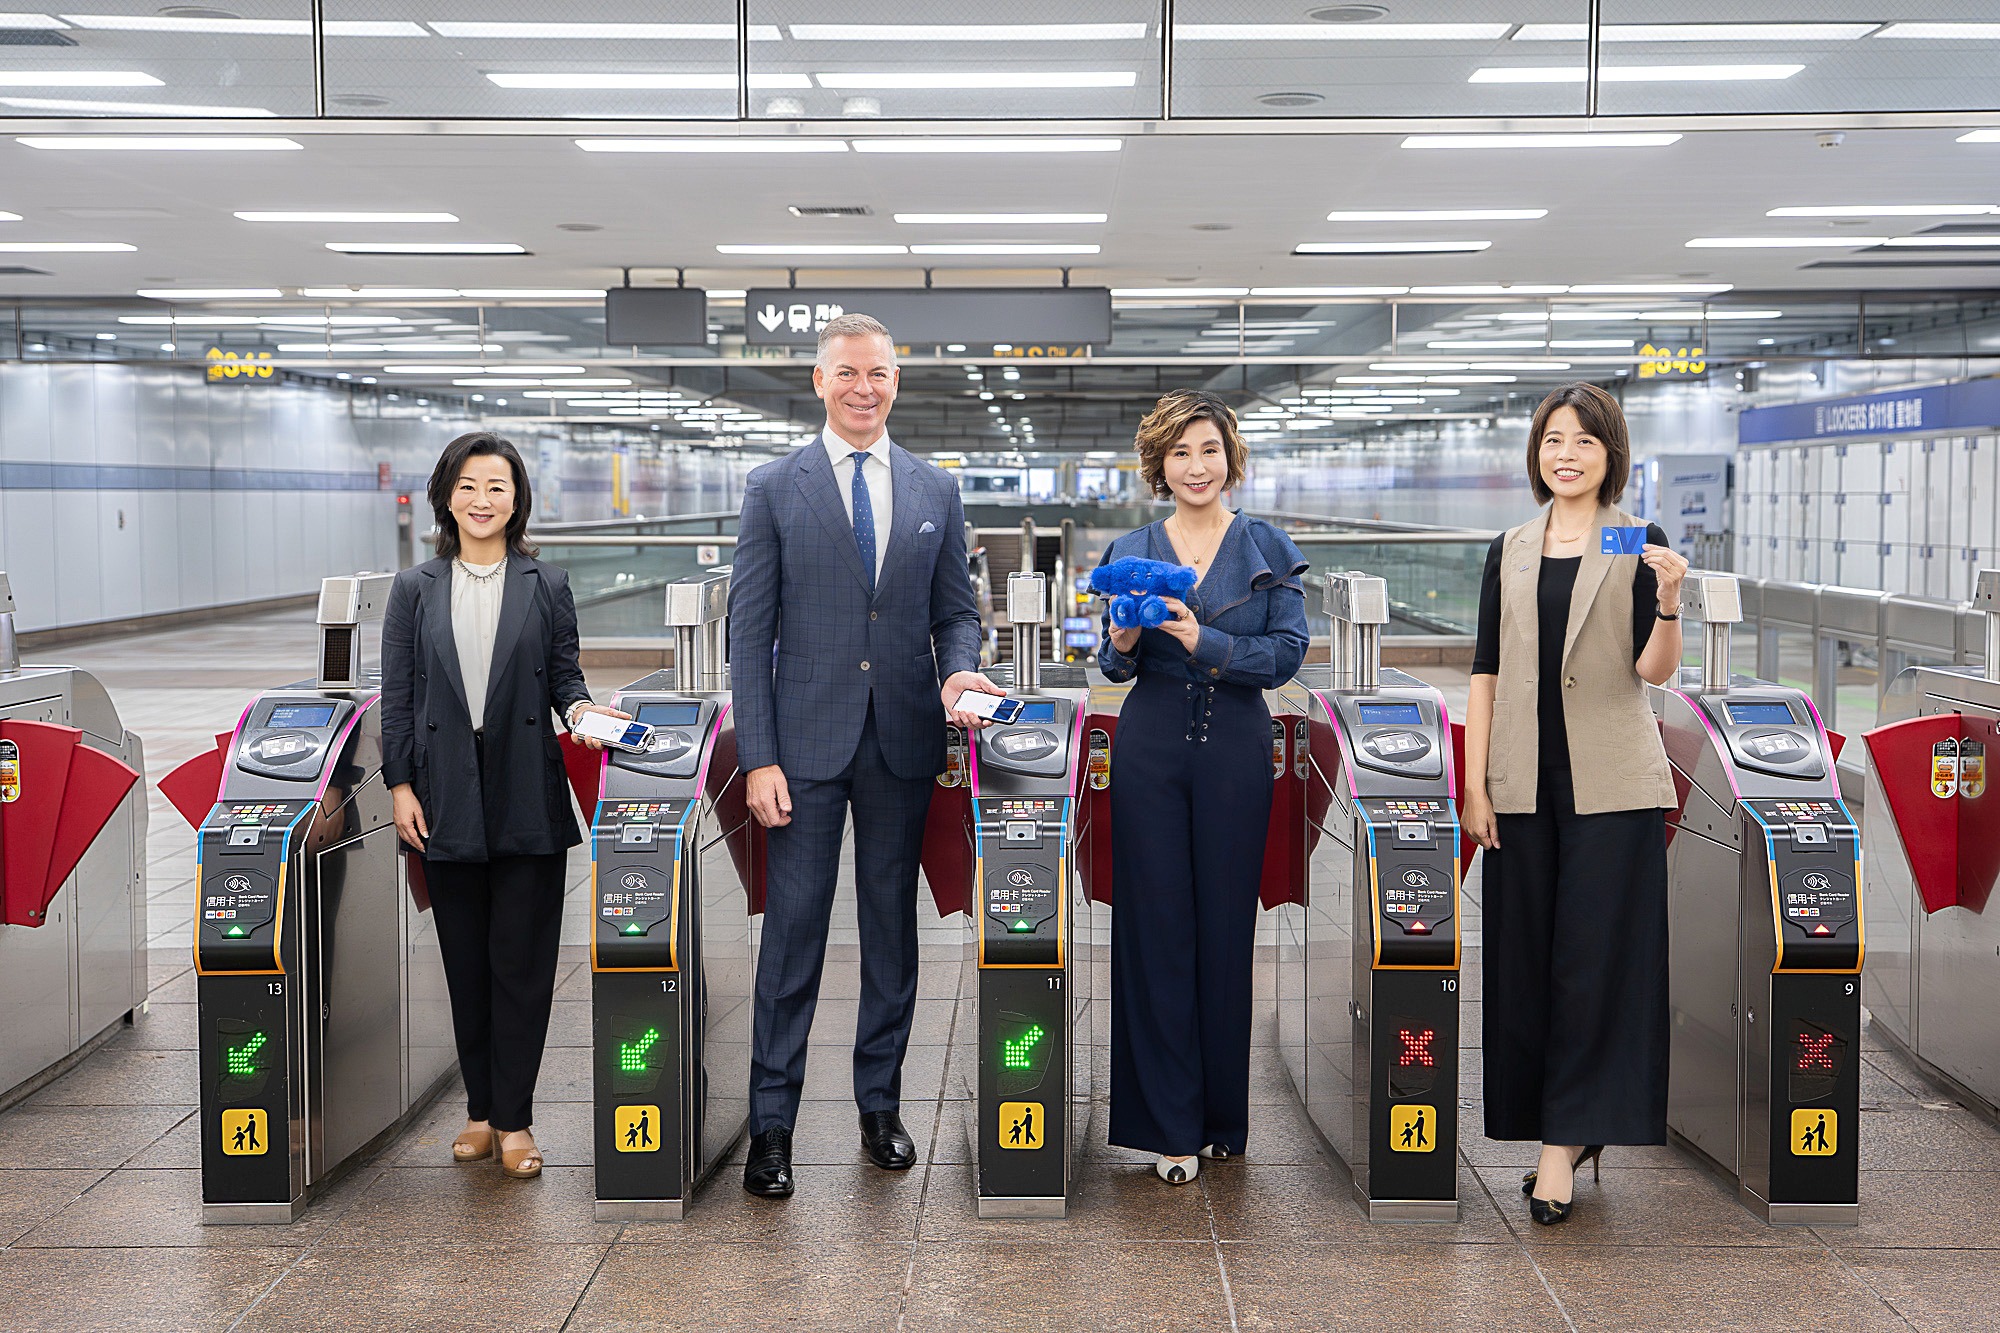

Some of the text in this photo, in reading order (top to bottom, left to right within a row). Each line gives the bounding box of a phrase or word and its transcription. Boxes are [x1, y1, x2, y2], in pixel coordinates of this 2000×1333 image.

[206, 895, 236, 907] 信用卡
[603, 893, 633, 904] 信用卡
[990, 889, 1020, 901] 信用卡
[1386, 889, 1415, 901] 信用卡
[1787, 893, 1817, 905] 信用卡
[267, 983, 283, 995] 13
[661, 979, 676, 992] 12
[1047, 977, 1060, 990] 11
[1441, 979, 1456, 992] 10
[1844, 982, 1854, 995] 9
